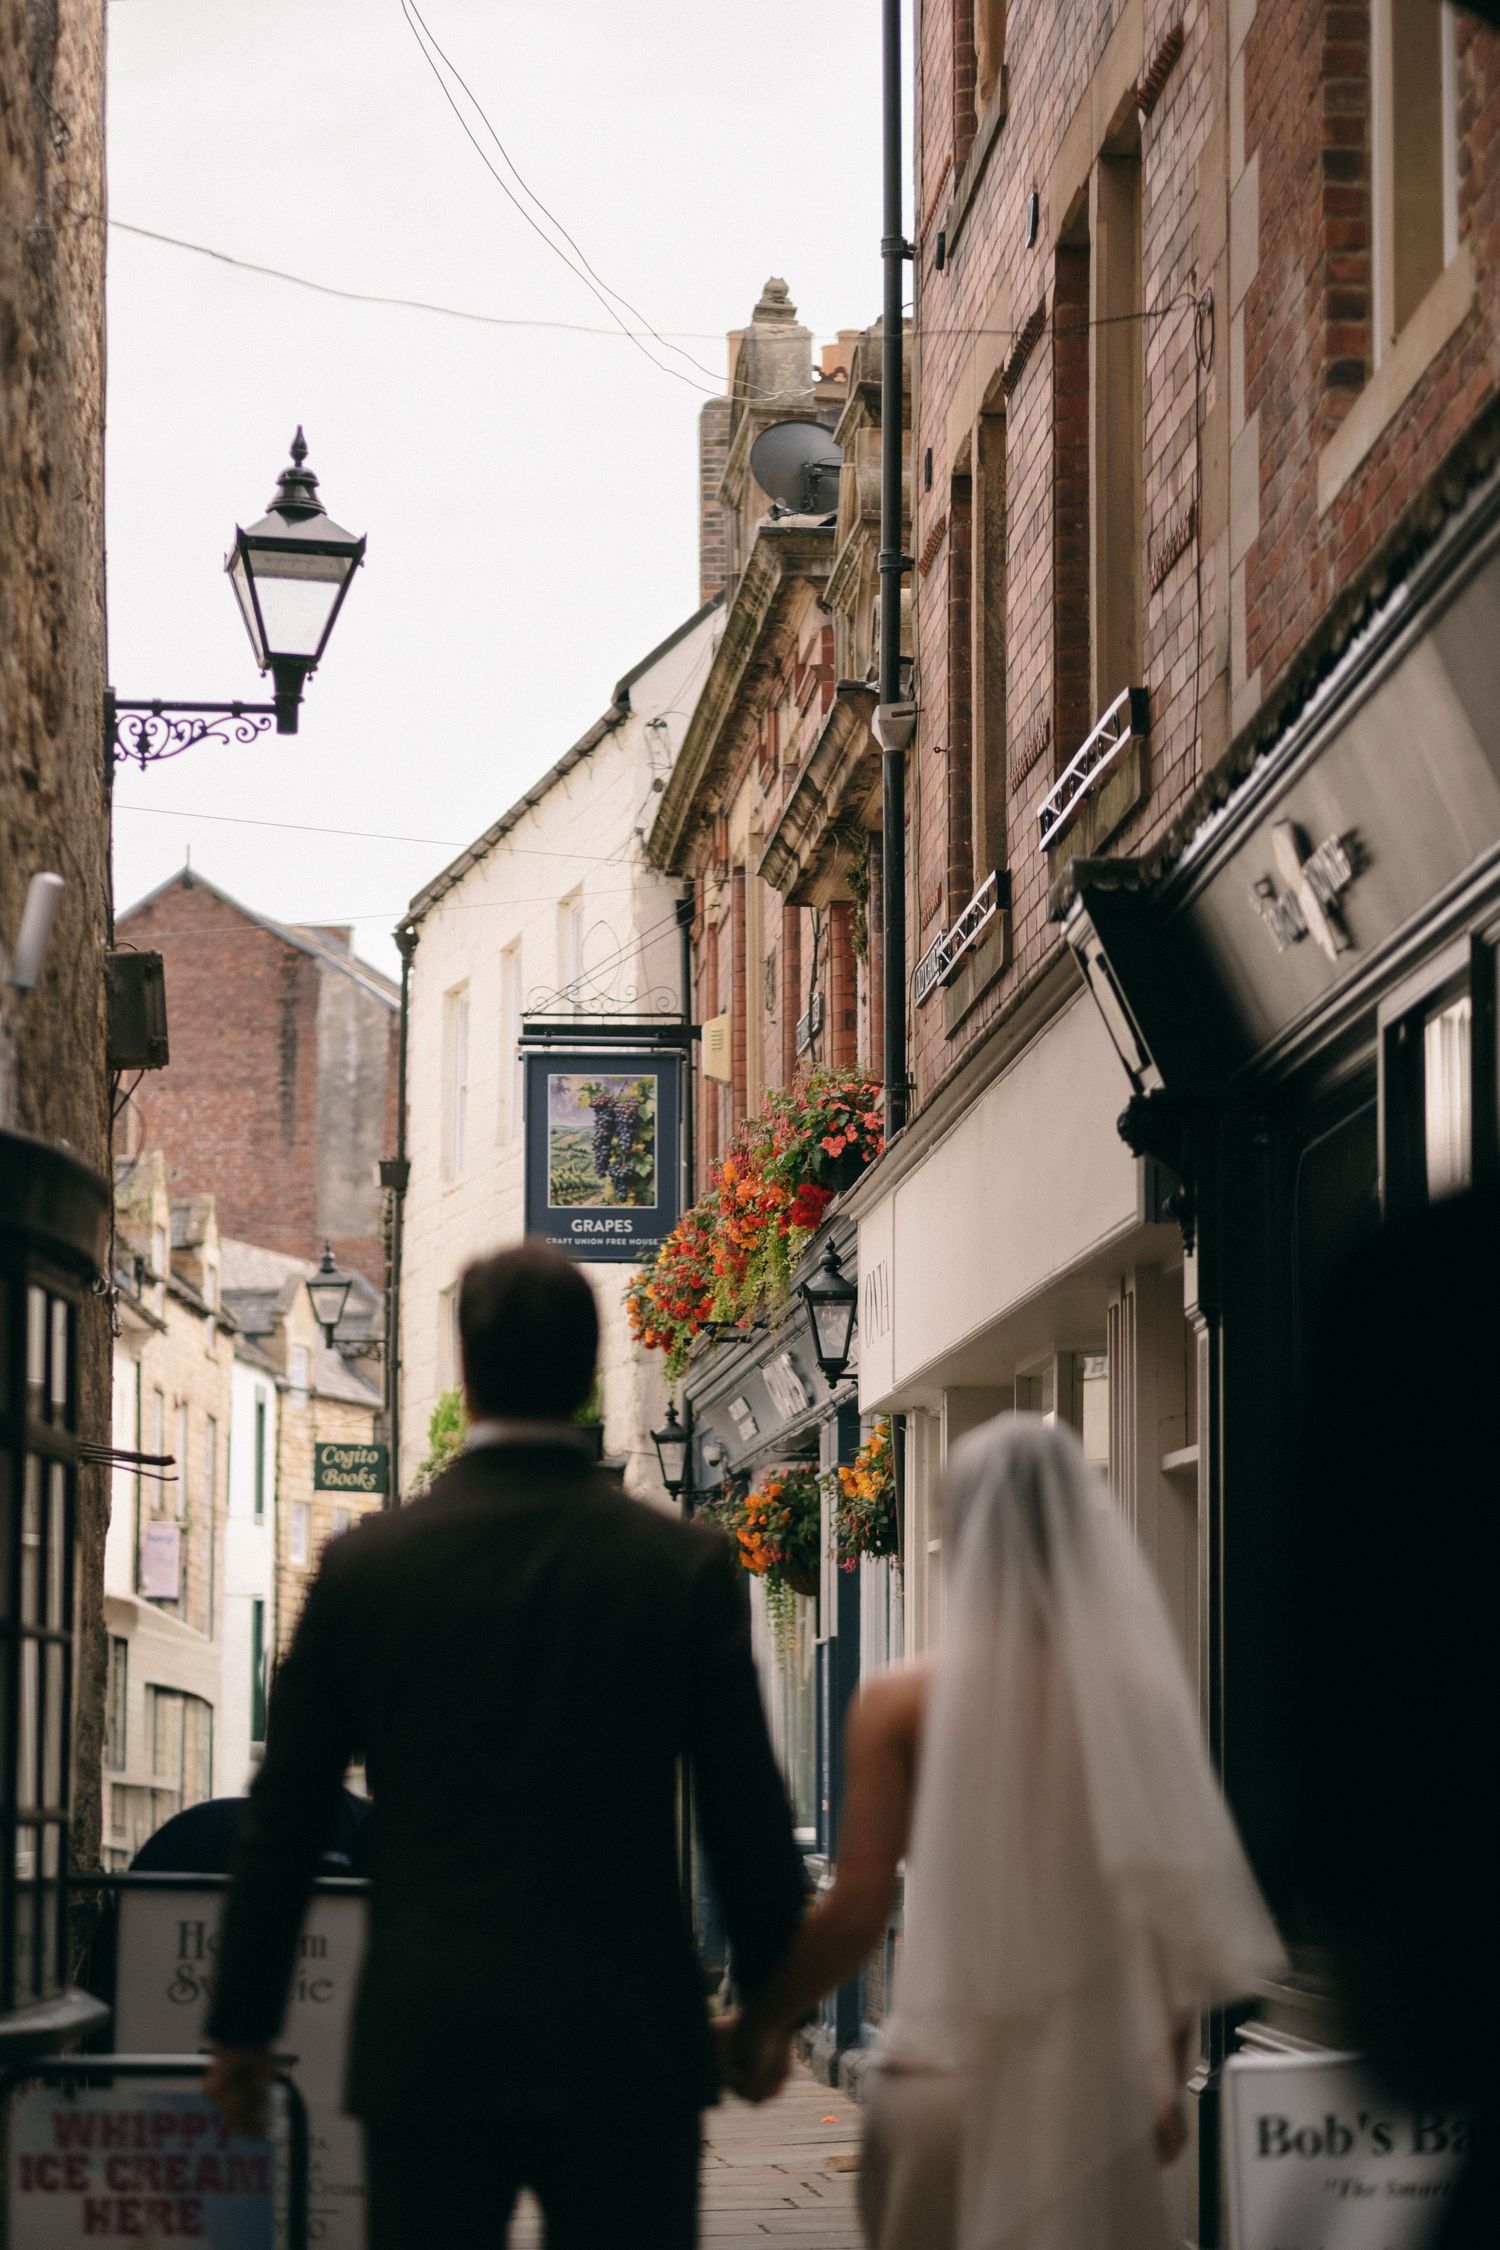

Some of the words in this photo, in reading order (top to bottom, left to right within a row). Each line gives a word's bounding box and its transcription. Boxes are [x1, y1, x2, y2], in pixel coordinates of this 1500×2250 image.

[571, 1219, 633, 1233] GRAPES
[546, 1237, 572, 1245] CRAFT
[574, 1237, 603, 1245] UNION
[629, 1238, 658, 1246] HOUSE
[321, 1445, 379, 1470] Cogito
[321, 1466, 378, 1490] Books
[1257, 2111, 1393, 2158] Bob's
[19, 2153, 89, 2192] ICE
[106, 2154, 270, 2193] CREAM
[82, 2198, 204, 2236] HERE
